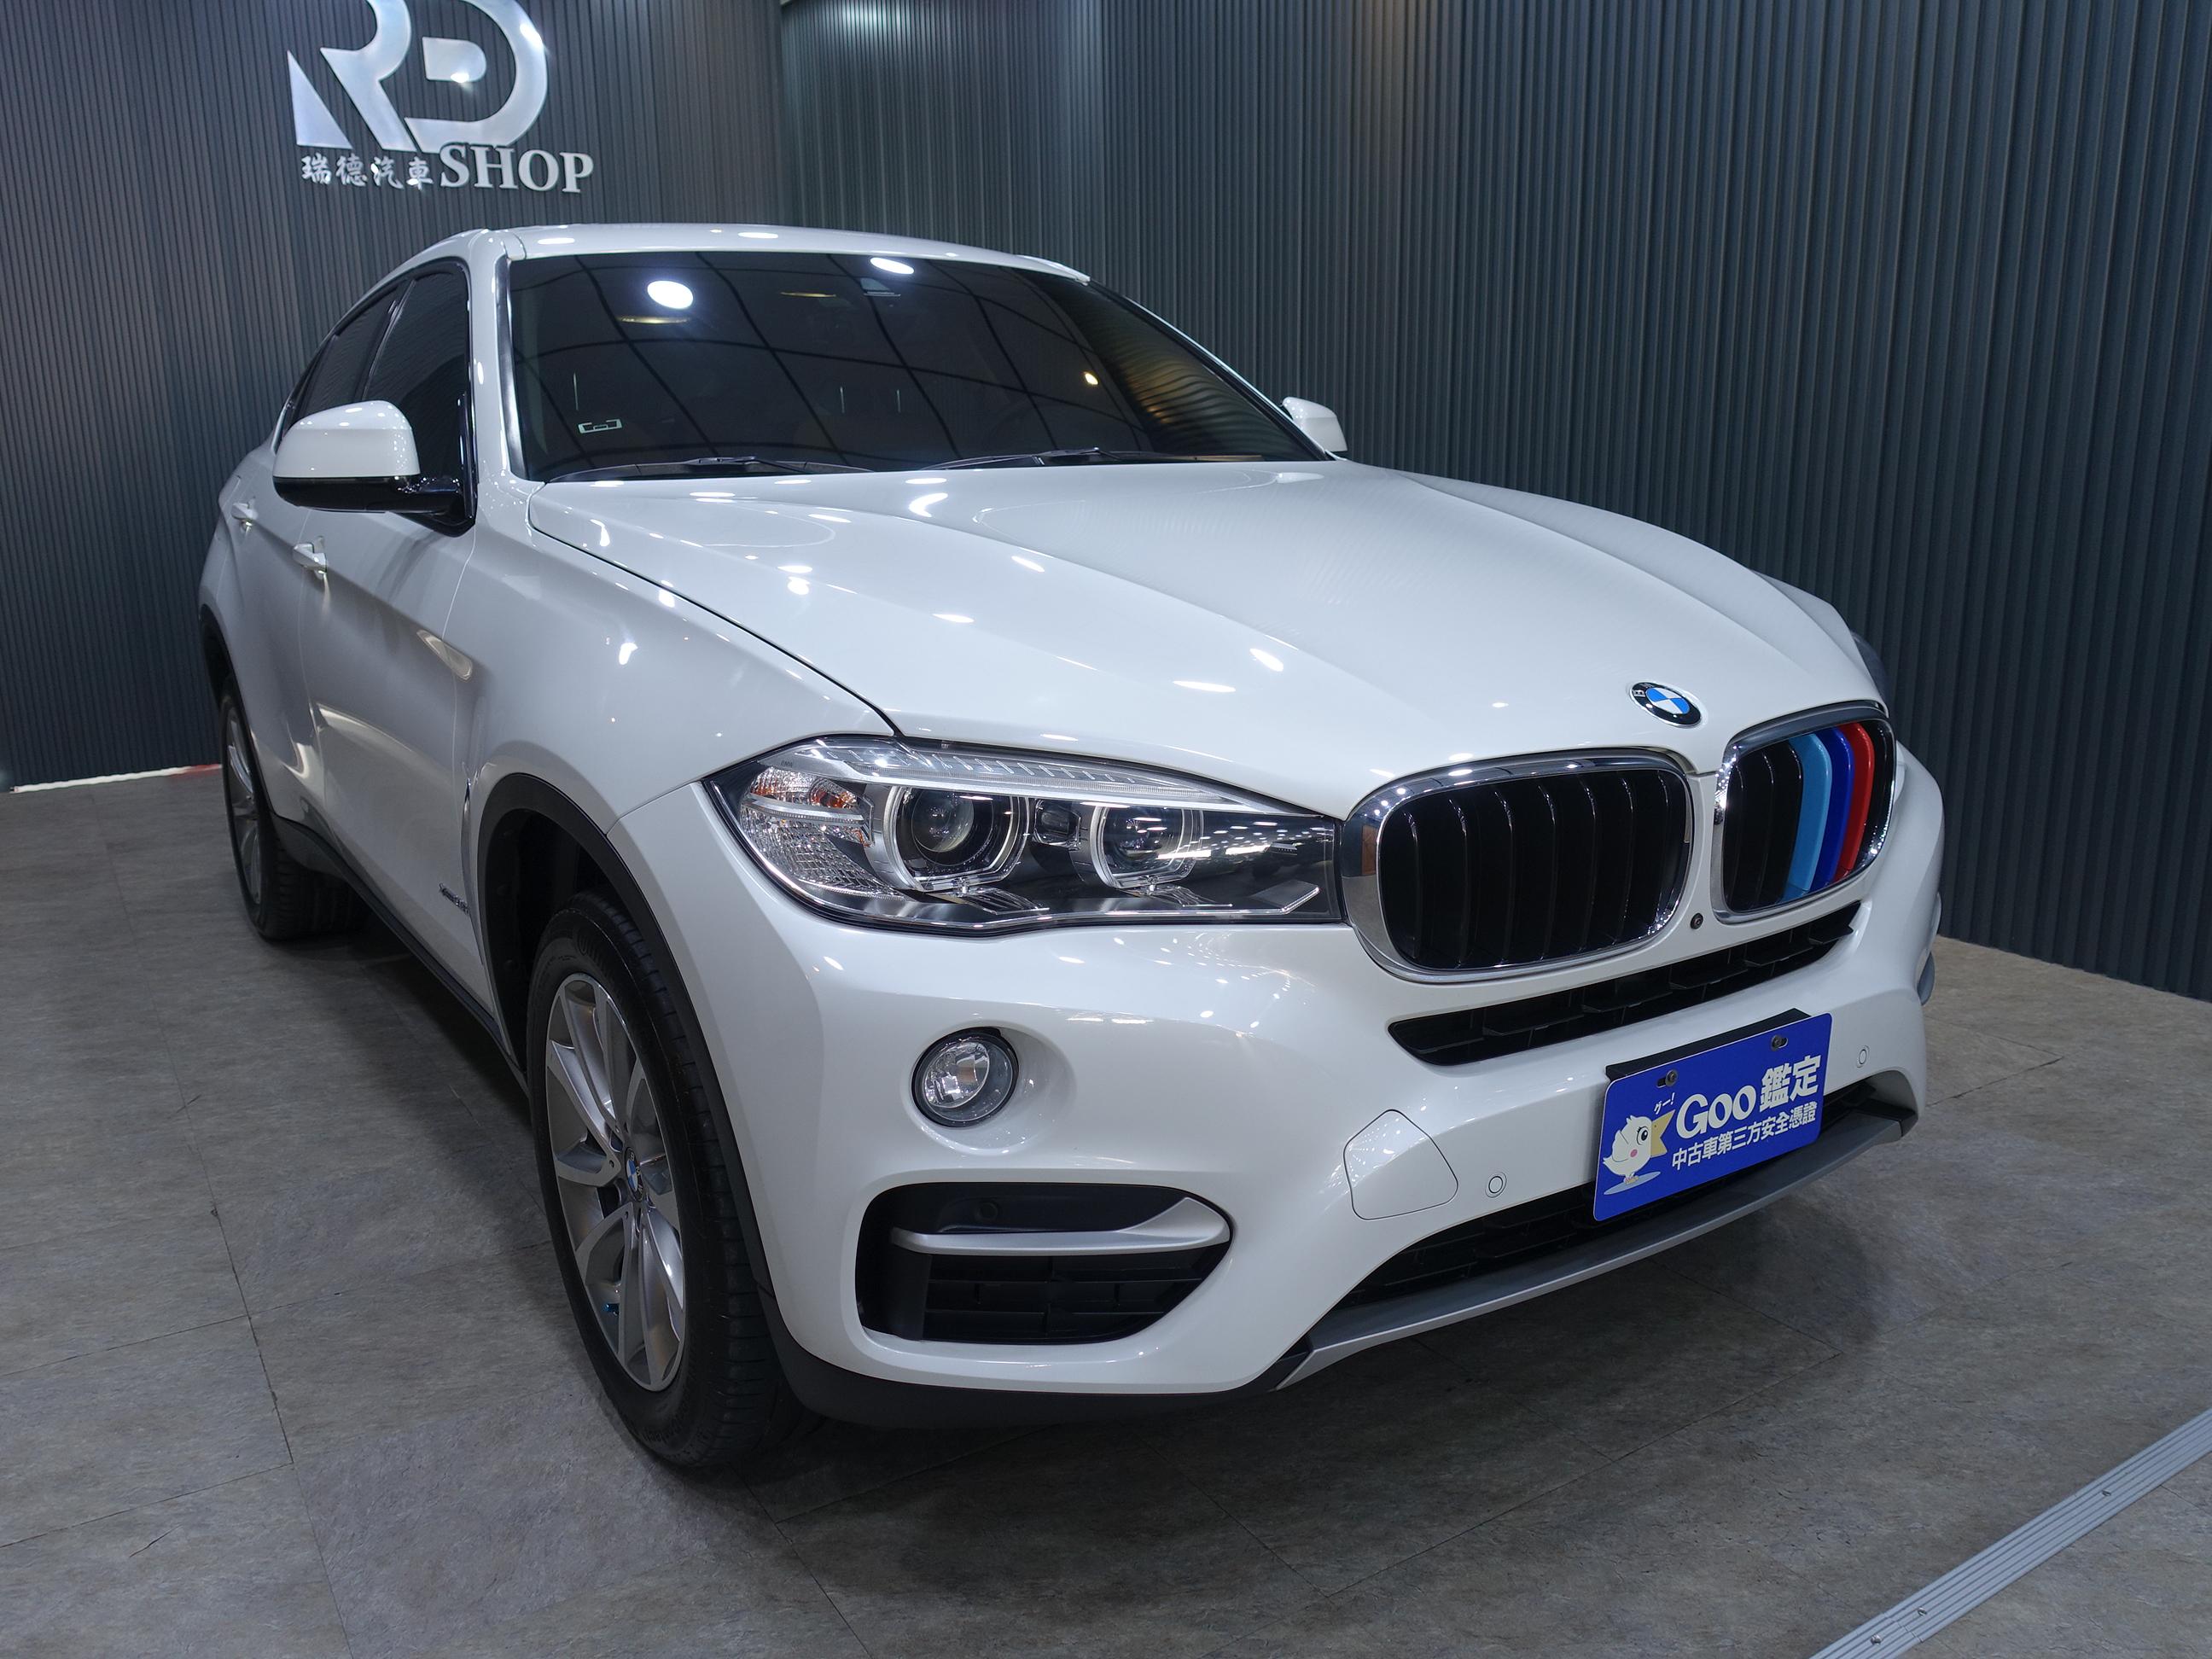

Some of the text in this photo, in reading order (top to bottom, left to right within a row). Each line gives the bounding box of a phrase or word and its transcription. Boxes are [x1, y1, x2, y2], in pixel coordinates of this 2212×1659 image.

[300, 142, 594, 194] 瑞德汽車 SHOP
[1676, 1054, 1821, 1138] Goo 鑑定
[1671, 1101, 1818, 1171] 中古車第三方安全憑證
